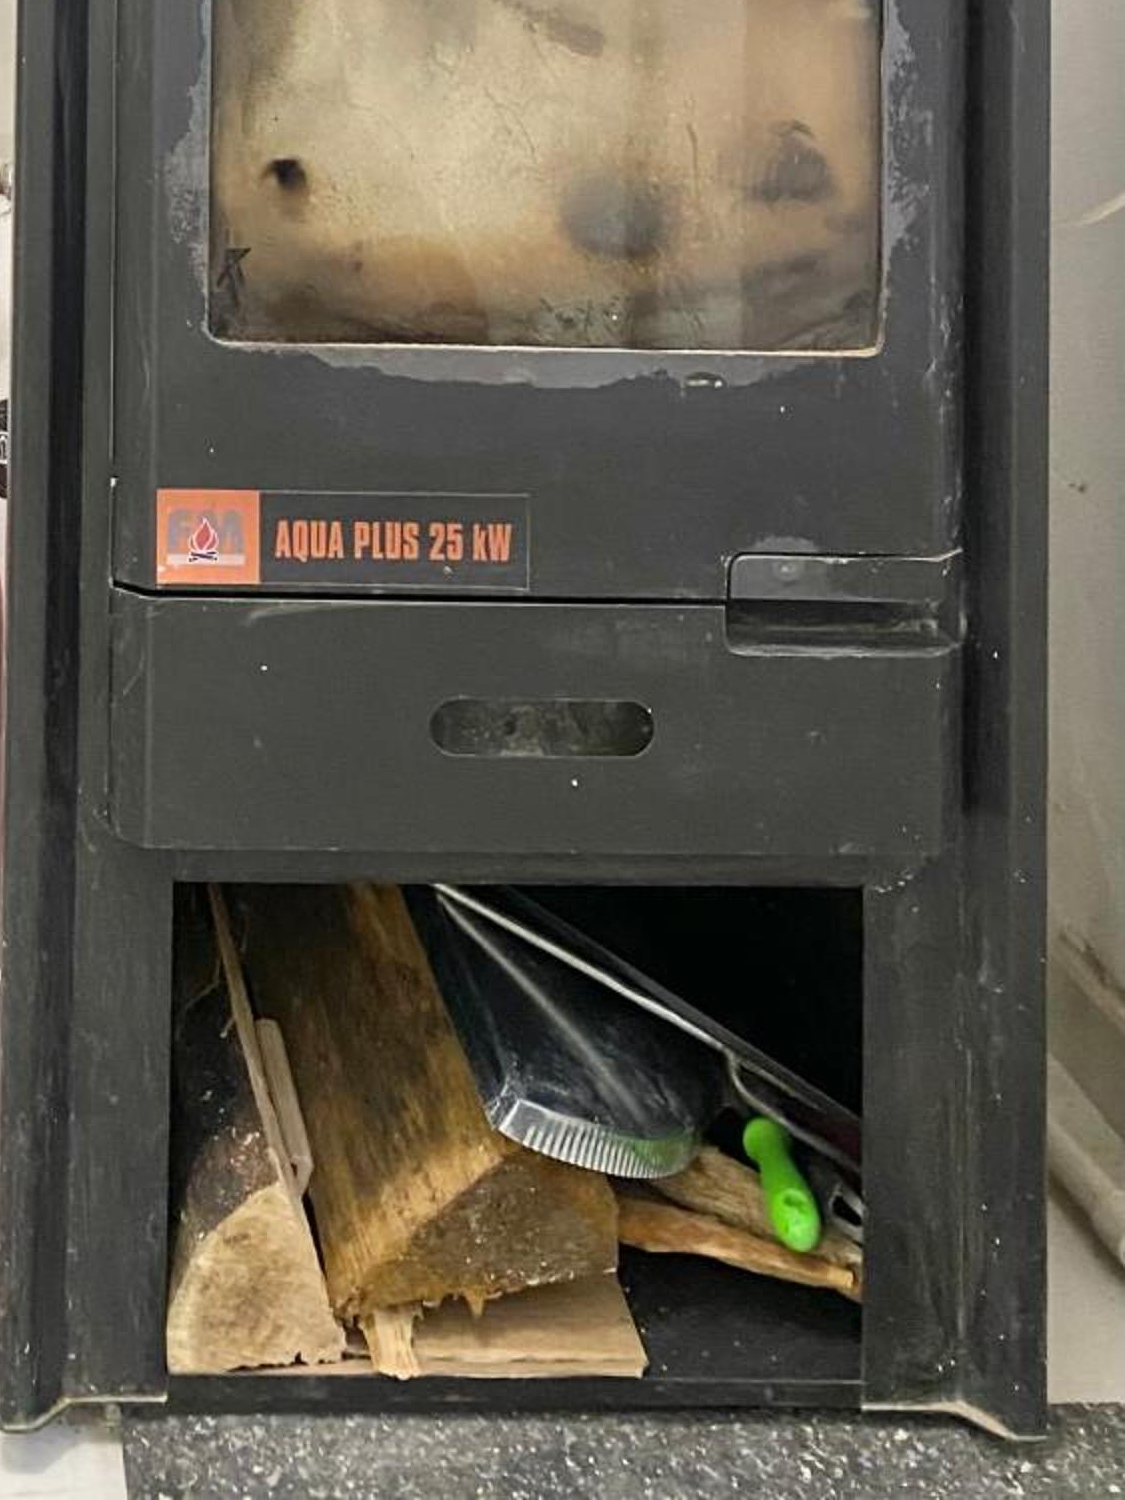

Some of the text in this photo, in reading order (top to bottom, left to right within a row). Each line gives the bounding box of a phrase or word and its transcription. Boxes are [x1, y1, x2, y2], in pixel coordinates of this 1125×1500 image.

[275, 519, 344, 563] AQUA
[354, 521, 419, 561] PLUS
[429, 522, 463, 562] 25
